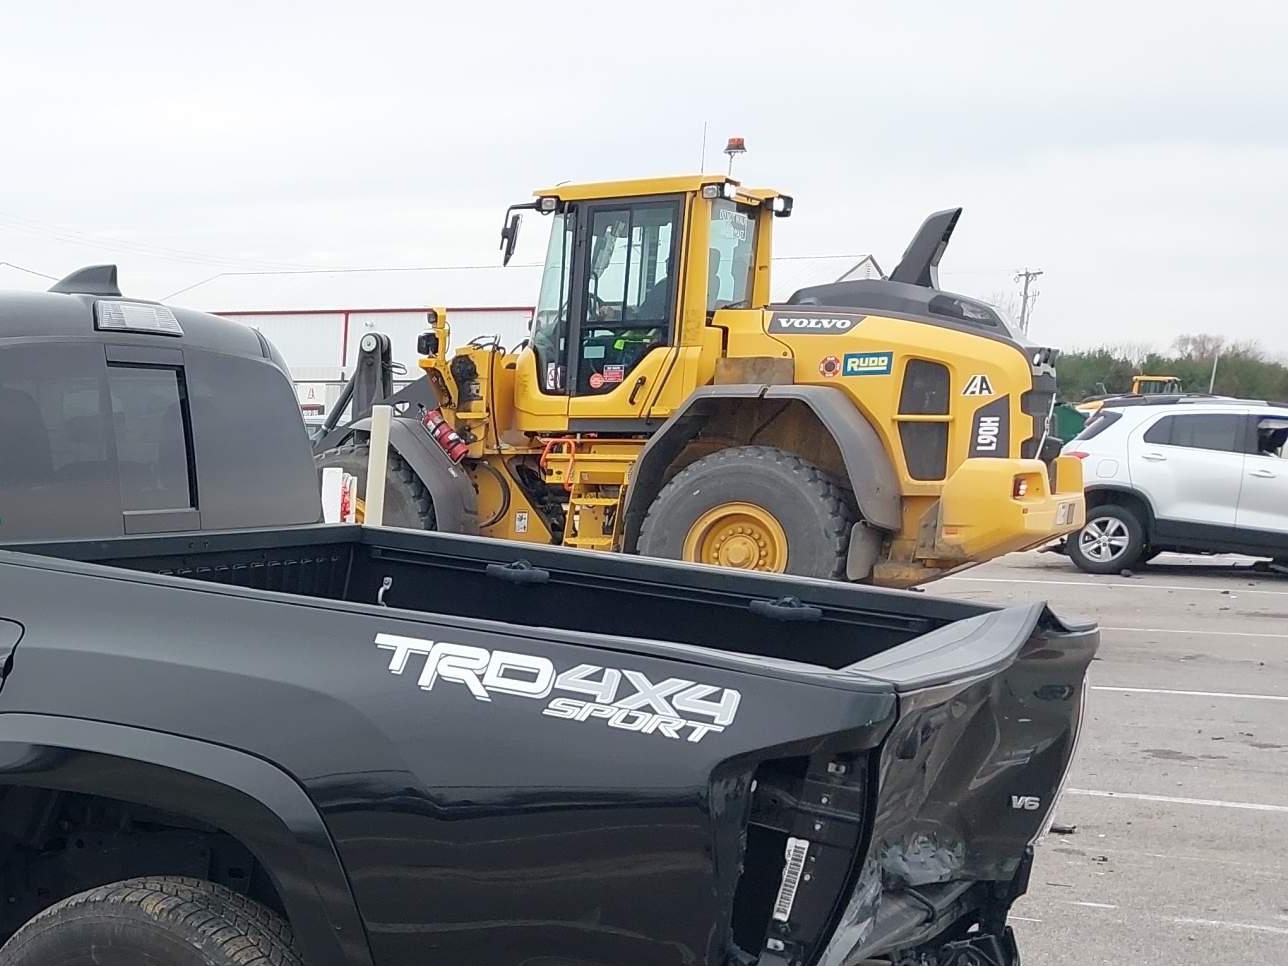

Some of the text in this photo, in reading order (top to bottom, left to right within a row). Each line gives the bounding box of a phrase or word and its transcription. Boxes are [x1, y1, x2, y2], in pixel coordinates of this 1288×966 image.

[778, 318, 851, 329] VOLVO
[846, 356, 889, 372] RUDD
[976, 416, 1000, 451] L90H
[374, 632, 557, 702] TRD
[542, 698, 725, 743] SPORT
[1011, 795, 1041, 810] V6
